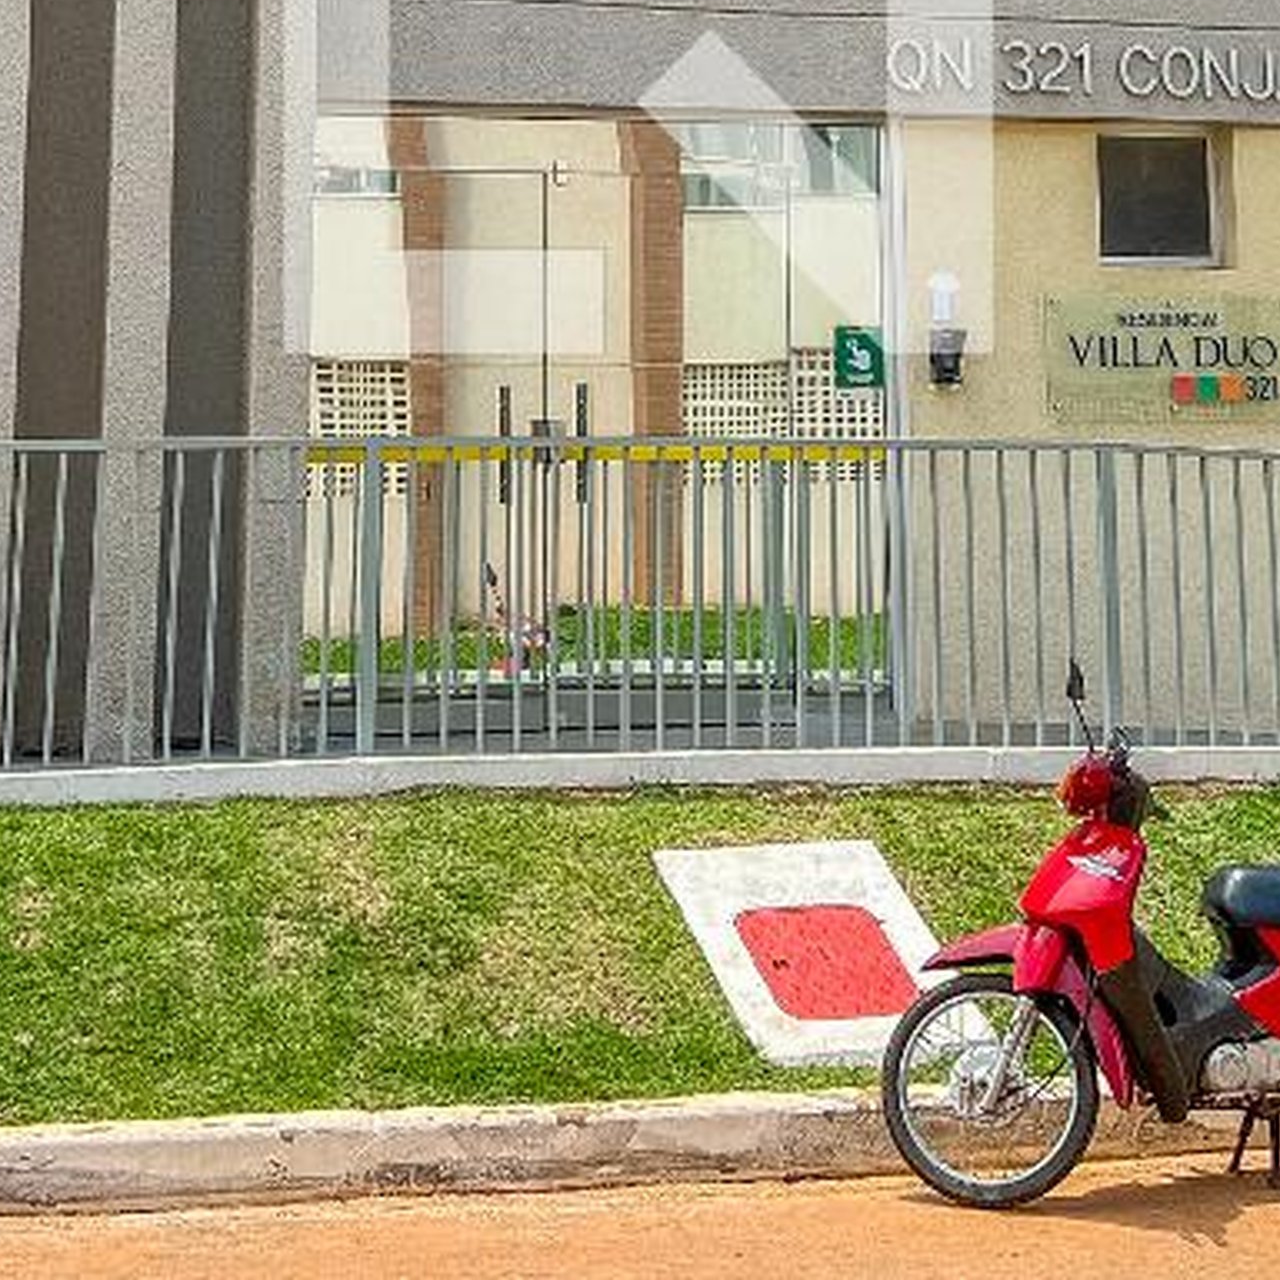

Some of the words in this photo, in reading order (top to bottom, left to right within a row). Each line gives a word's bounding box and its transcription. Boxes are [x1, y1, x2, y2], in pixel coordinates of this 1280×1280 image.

[886, 37, 974, 91] QN
[1001, 38, 1094, 97] 321
[1068, 335, 1178, 368] VILLA
[1193, 335, 1278, 369] DUO
[1244, 374, 1280, 402] 321
